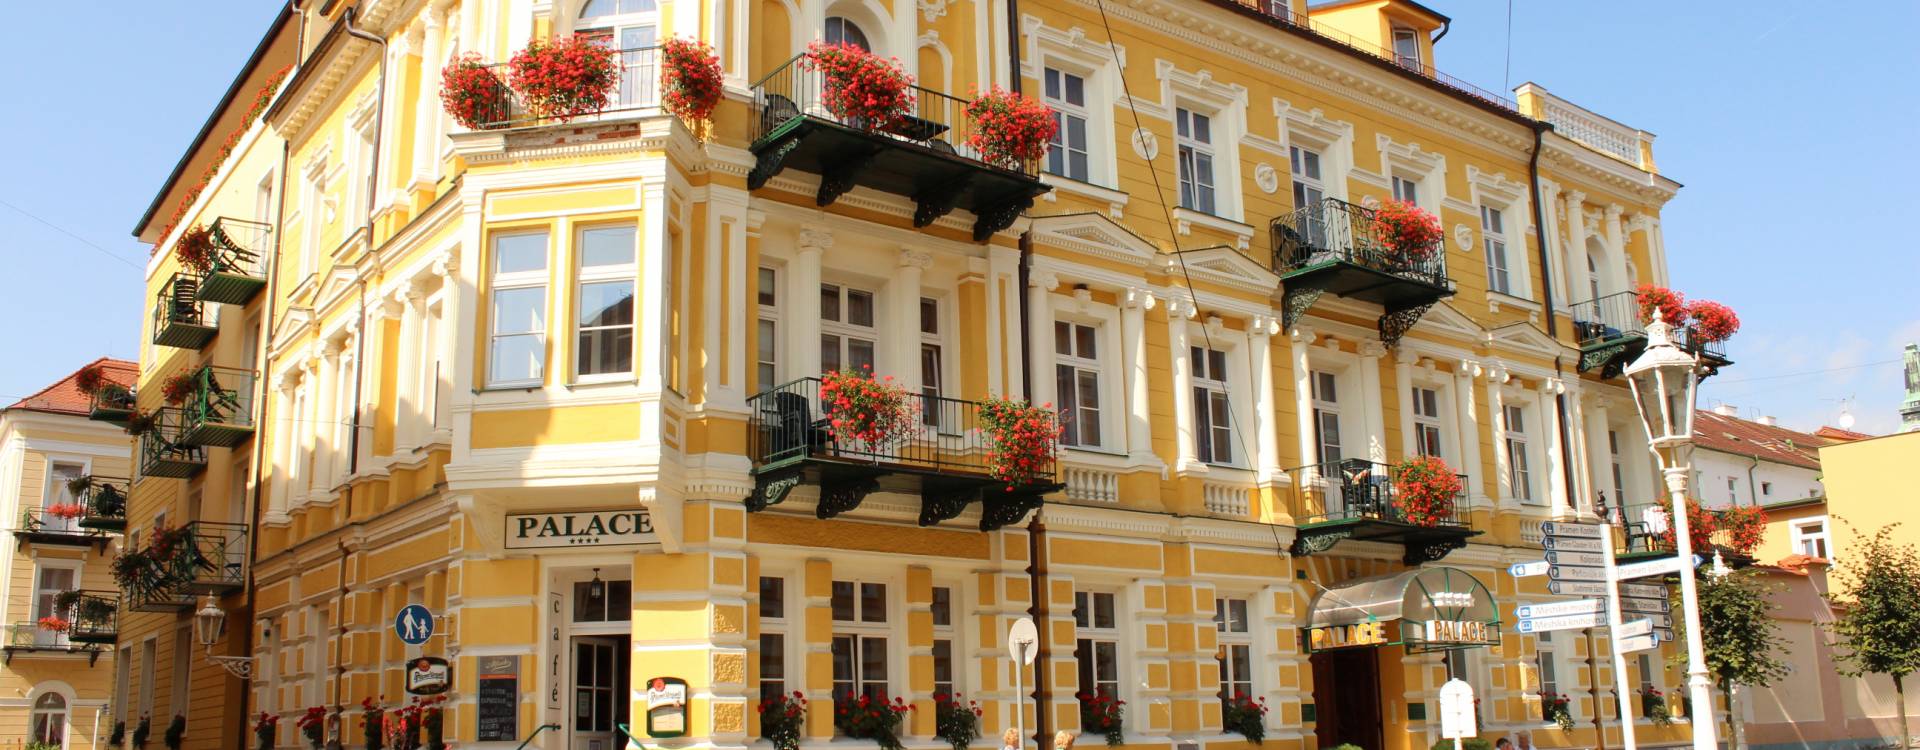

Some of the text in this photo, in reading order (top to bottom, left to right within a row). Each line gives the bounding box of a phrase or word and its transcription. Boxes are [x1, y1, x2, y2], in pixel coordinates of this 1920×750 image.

[516, 513, 654, 538] PALACE
[1312, 623, 1384, 648] PALACE
[1435, 620, 1487, 642] PALACE
[552, 600, 560, 703] café
